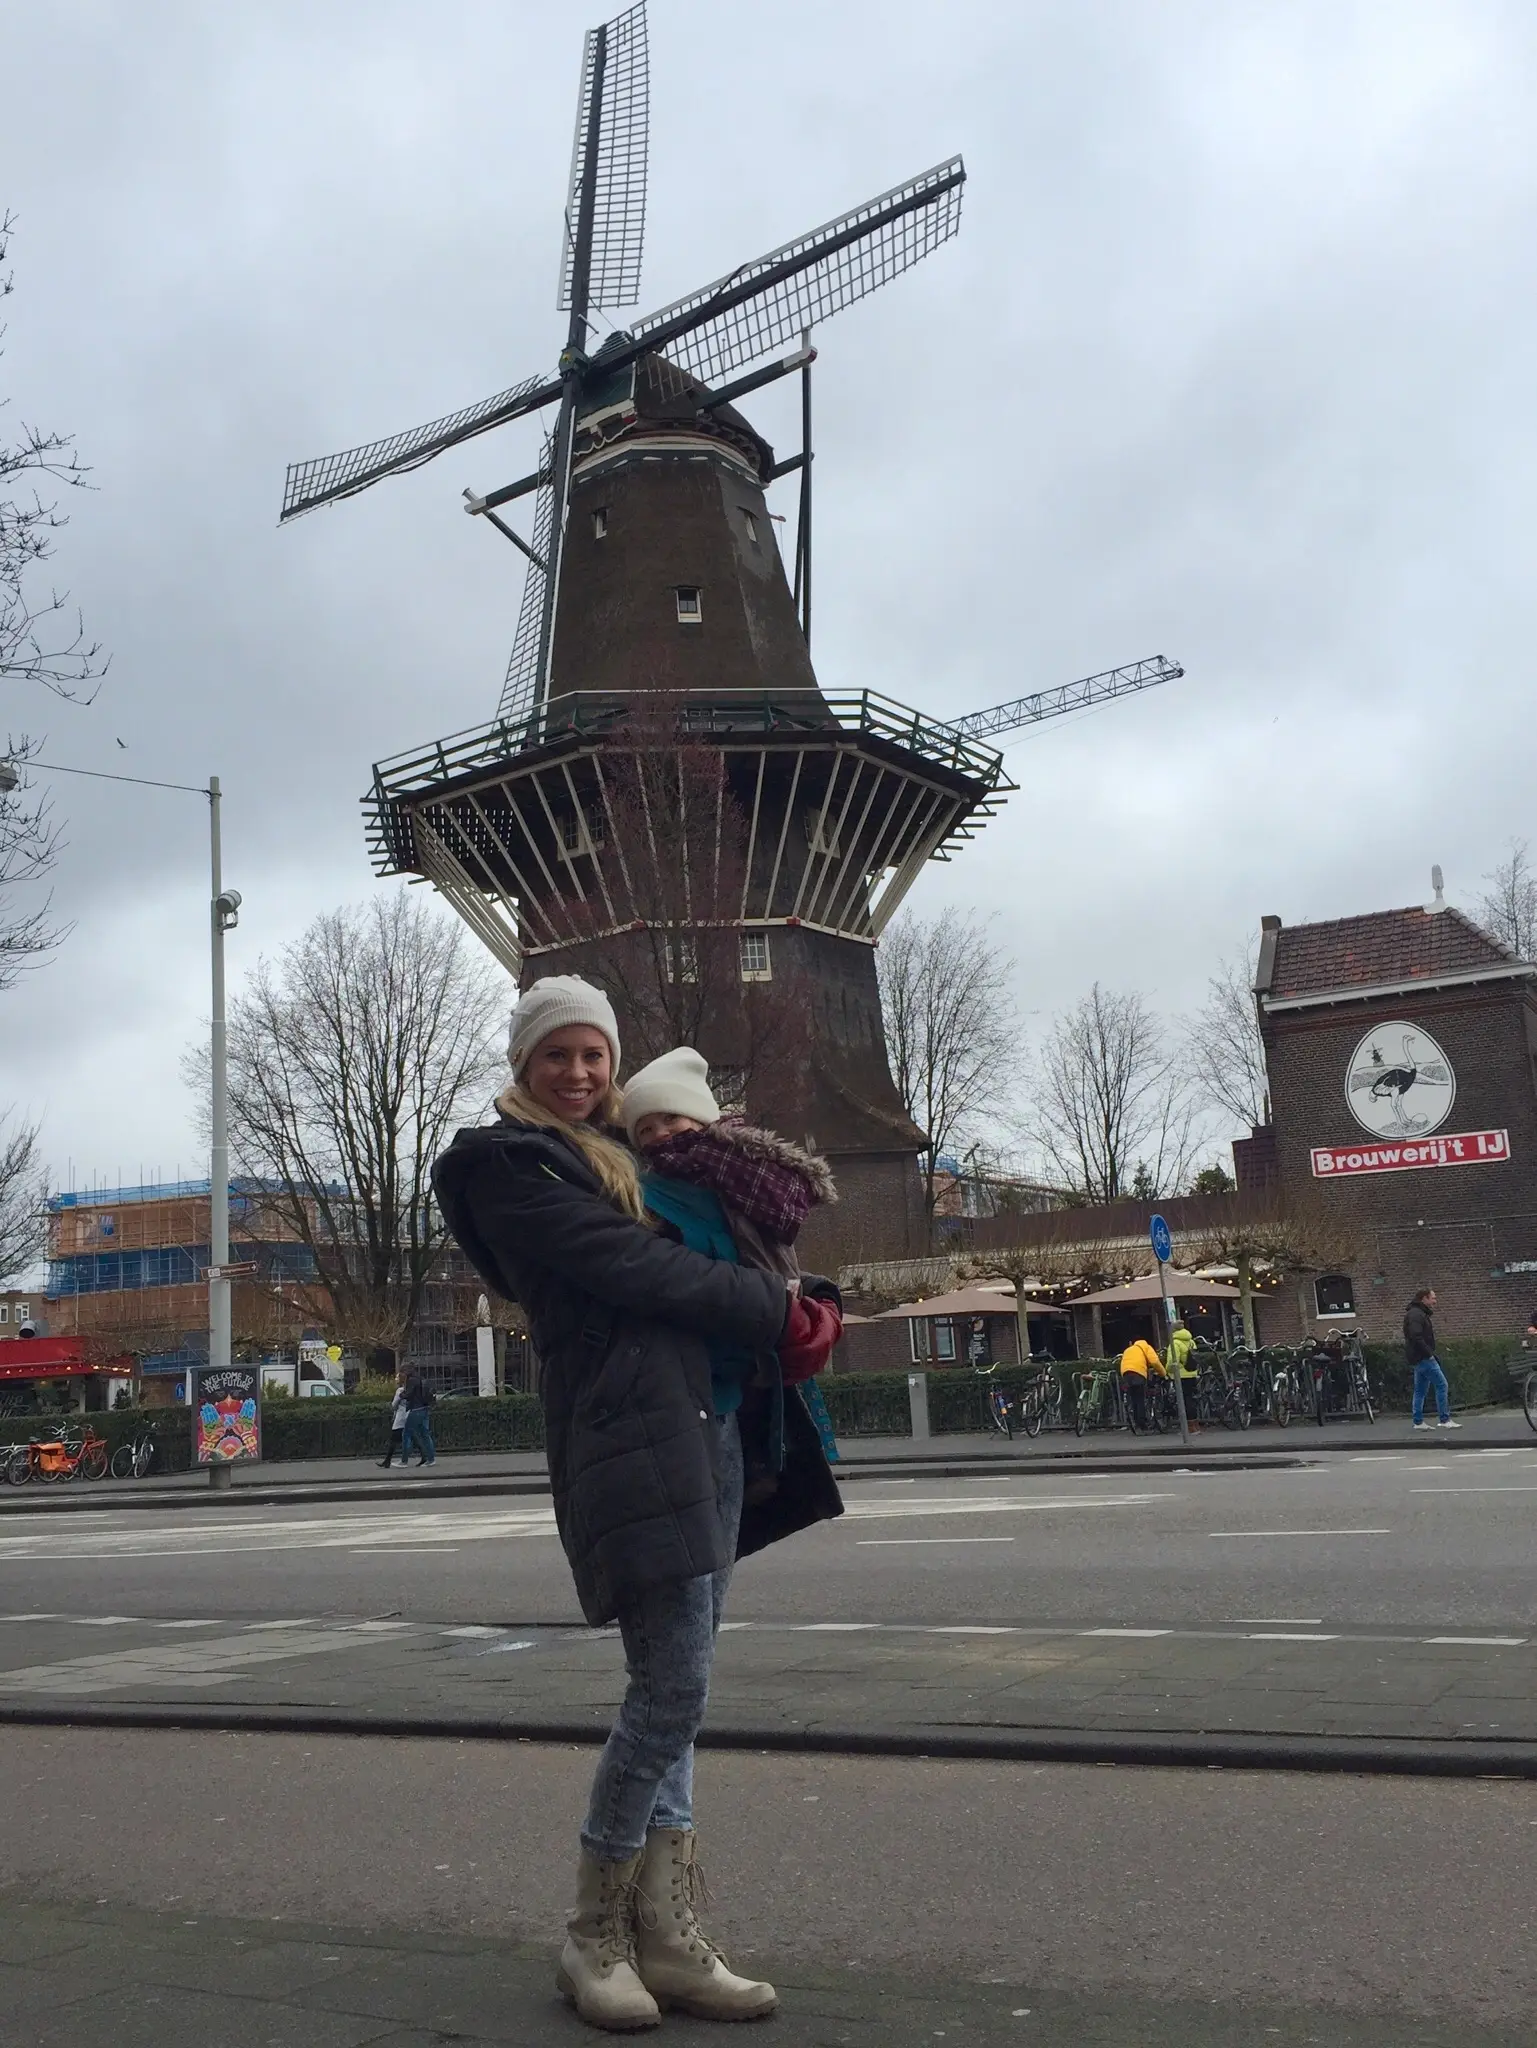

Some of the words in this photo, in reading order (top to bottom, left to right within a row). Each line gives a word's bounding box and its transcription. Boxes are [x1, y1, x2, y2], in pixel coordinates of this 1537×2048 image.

[1477, 1133, 1505, 1155] IJ
[201, 1371, 242, 1387] WELCOME
[245, 1374, 254, 1384] TO
[204, 1382, 221, 1394] THE
[222, 1378, 251, 1391] FUTURE
